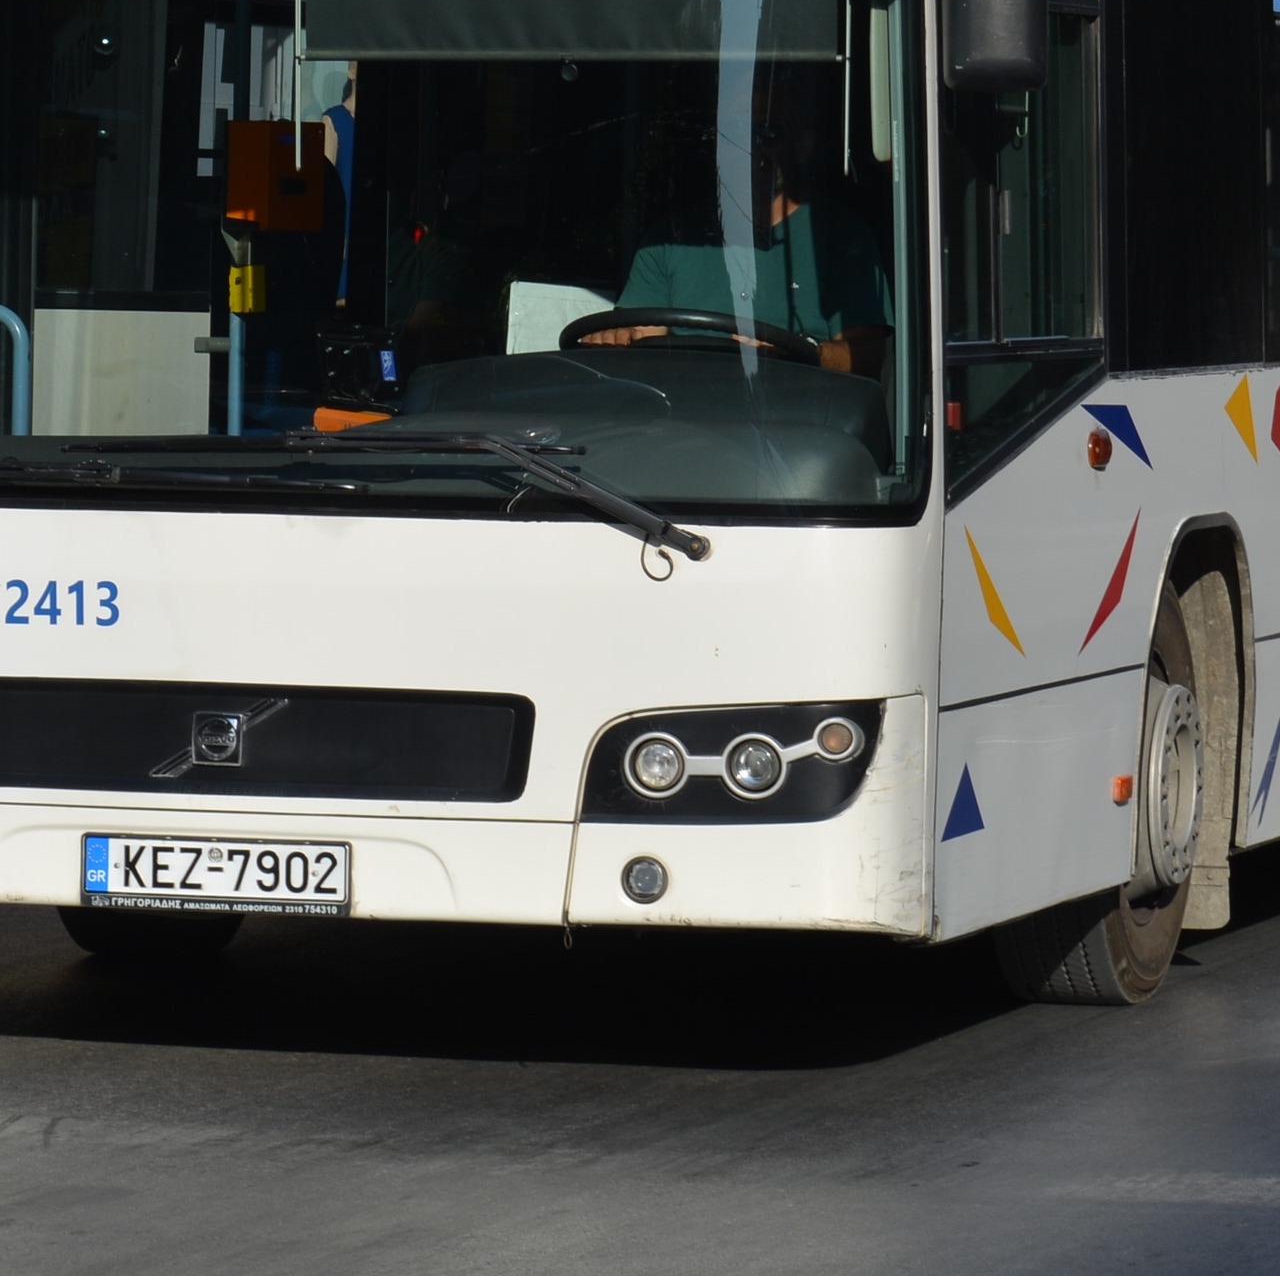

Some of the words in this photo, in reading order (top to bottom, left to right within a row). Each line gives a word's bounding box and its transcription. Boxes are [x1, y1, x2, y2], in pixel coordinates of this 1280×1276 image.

[4, 579, 120, 627] 2413
[87, 869, 106, 882] GR
[123, 844, 338, 895] KEZ-7902
[111, 896, 182, 909] ΓΡΗΓΟΡΙΑΔΗΣ
[304, 904, 338, 915] 754310
